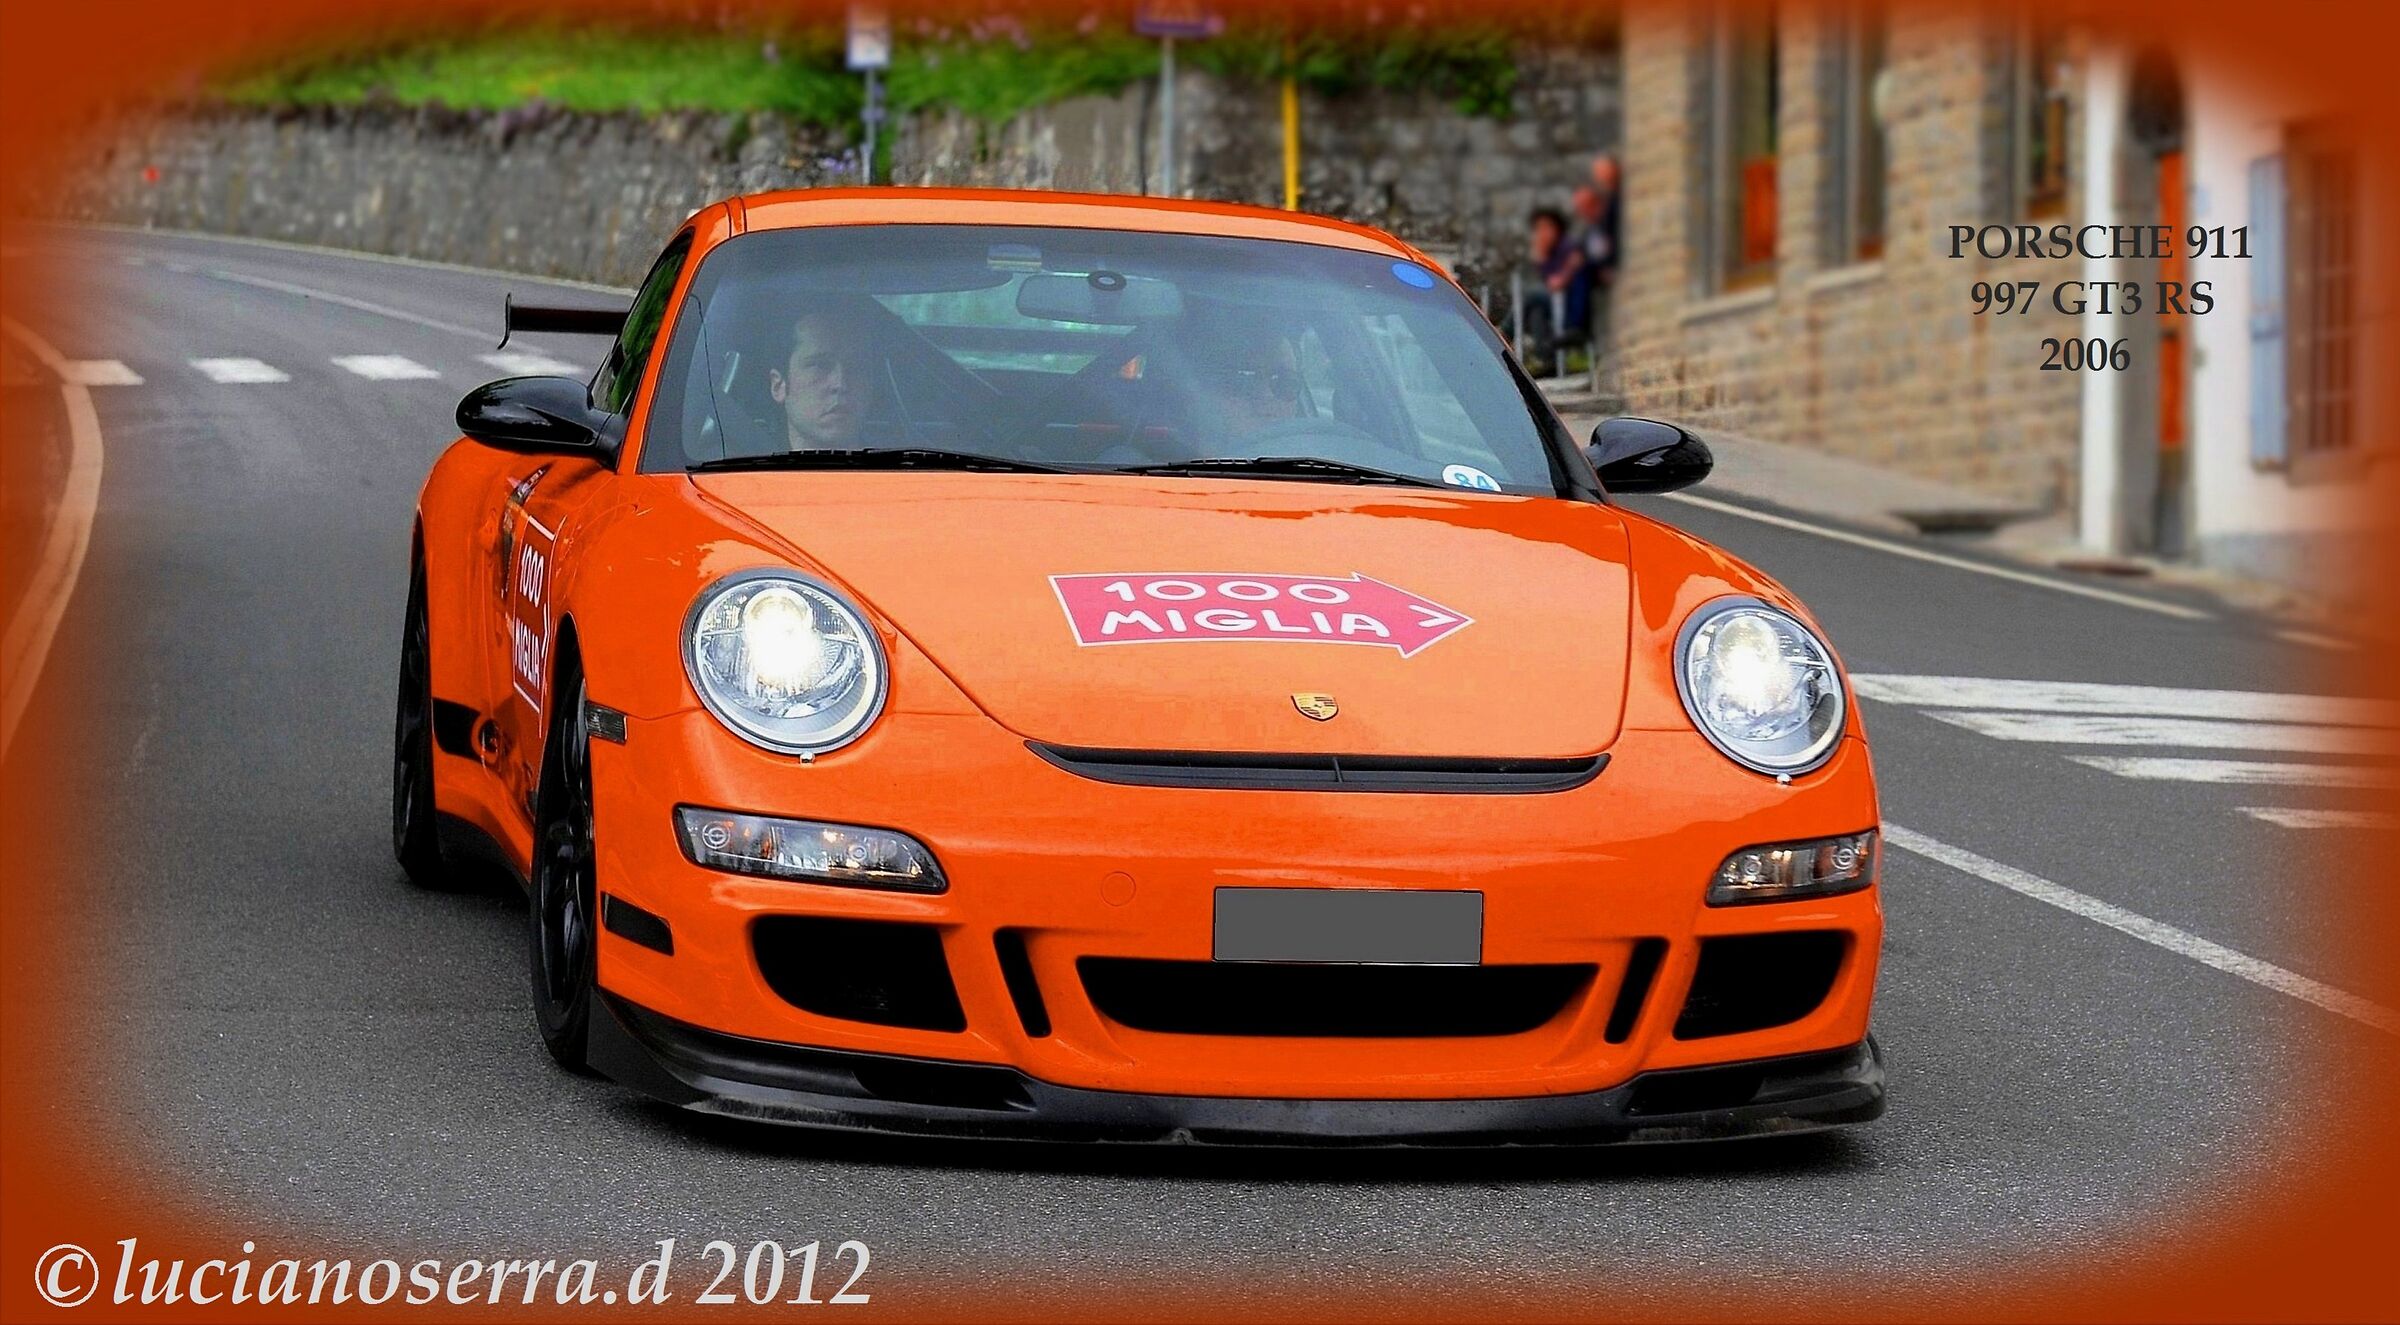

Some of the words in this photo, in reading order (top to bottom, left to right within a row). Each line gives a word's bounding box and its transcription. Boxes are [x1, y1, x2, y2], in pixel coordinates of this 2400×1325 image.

[520, 544, 545, 608] 1000
[1103, 580, 1351, 605] 1000
[1100, 608, 1391, 638] MIGLIA
[514, 617, 541, 691] MIGLIA
